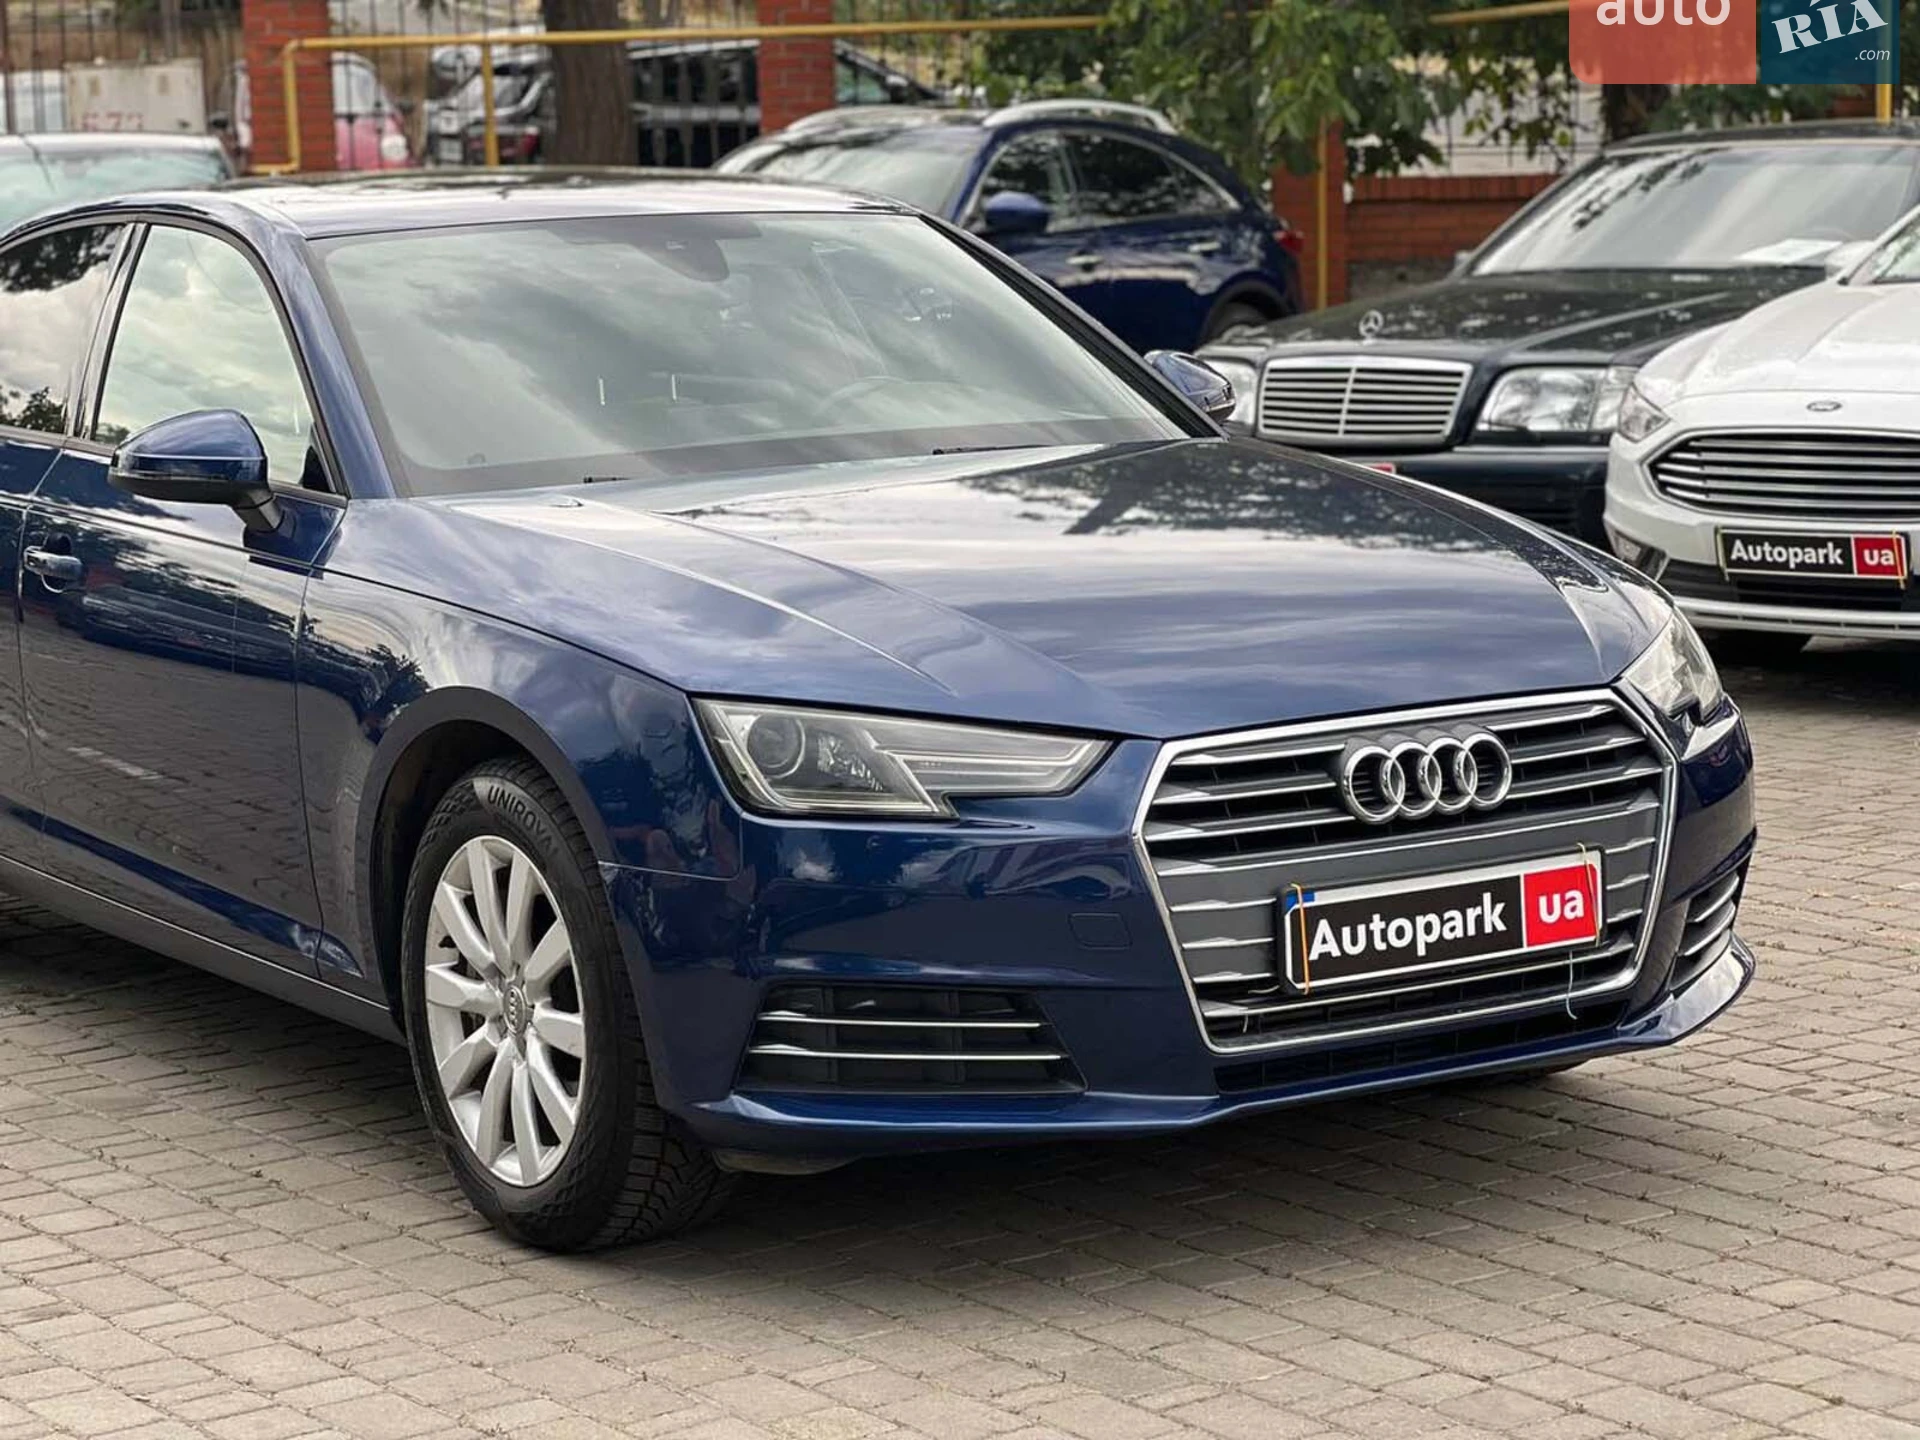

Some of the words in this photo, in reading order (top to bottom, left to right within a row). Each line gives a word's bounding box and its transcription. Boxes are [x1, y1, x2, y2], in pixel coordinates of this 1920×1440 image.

[1730, 539, 1844, 570] Autopark
[1863, 549, 1896, 566] ua
[1309, 892, 1508, 960] Autopark
[1538, 889, 1585, 924] ua
